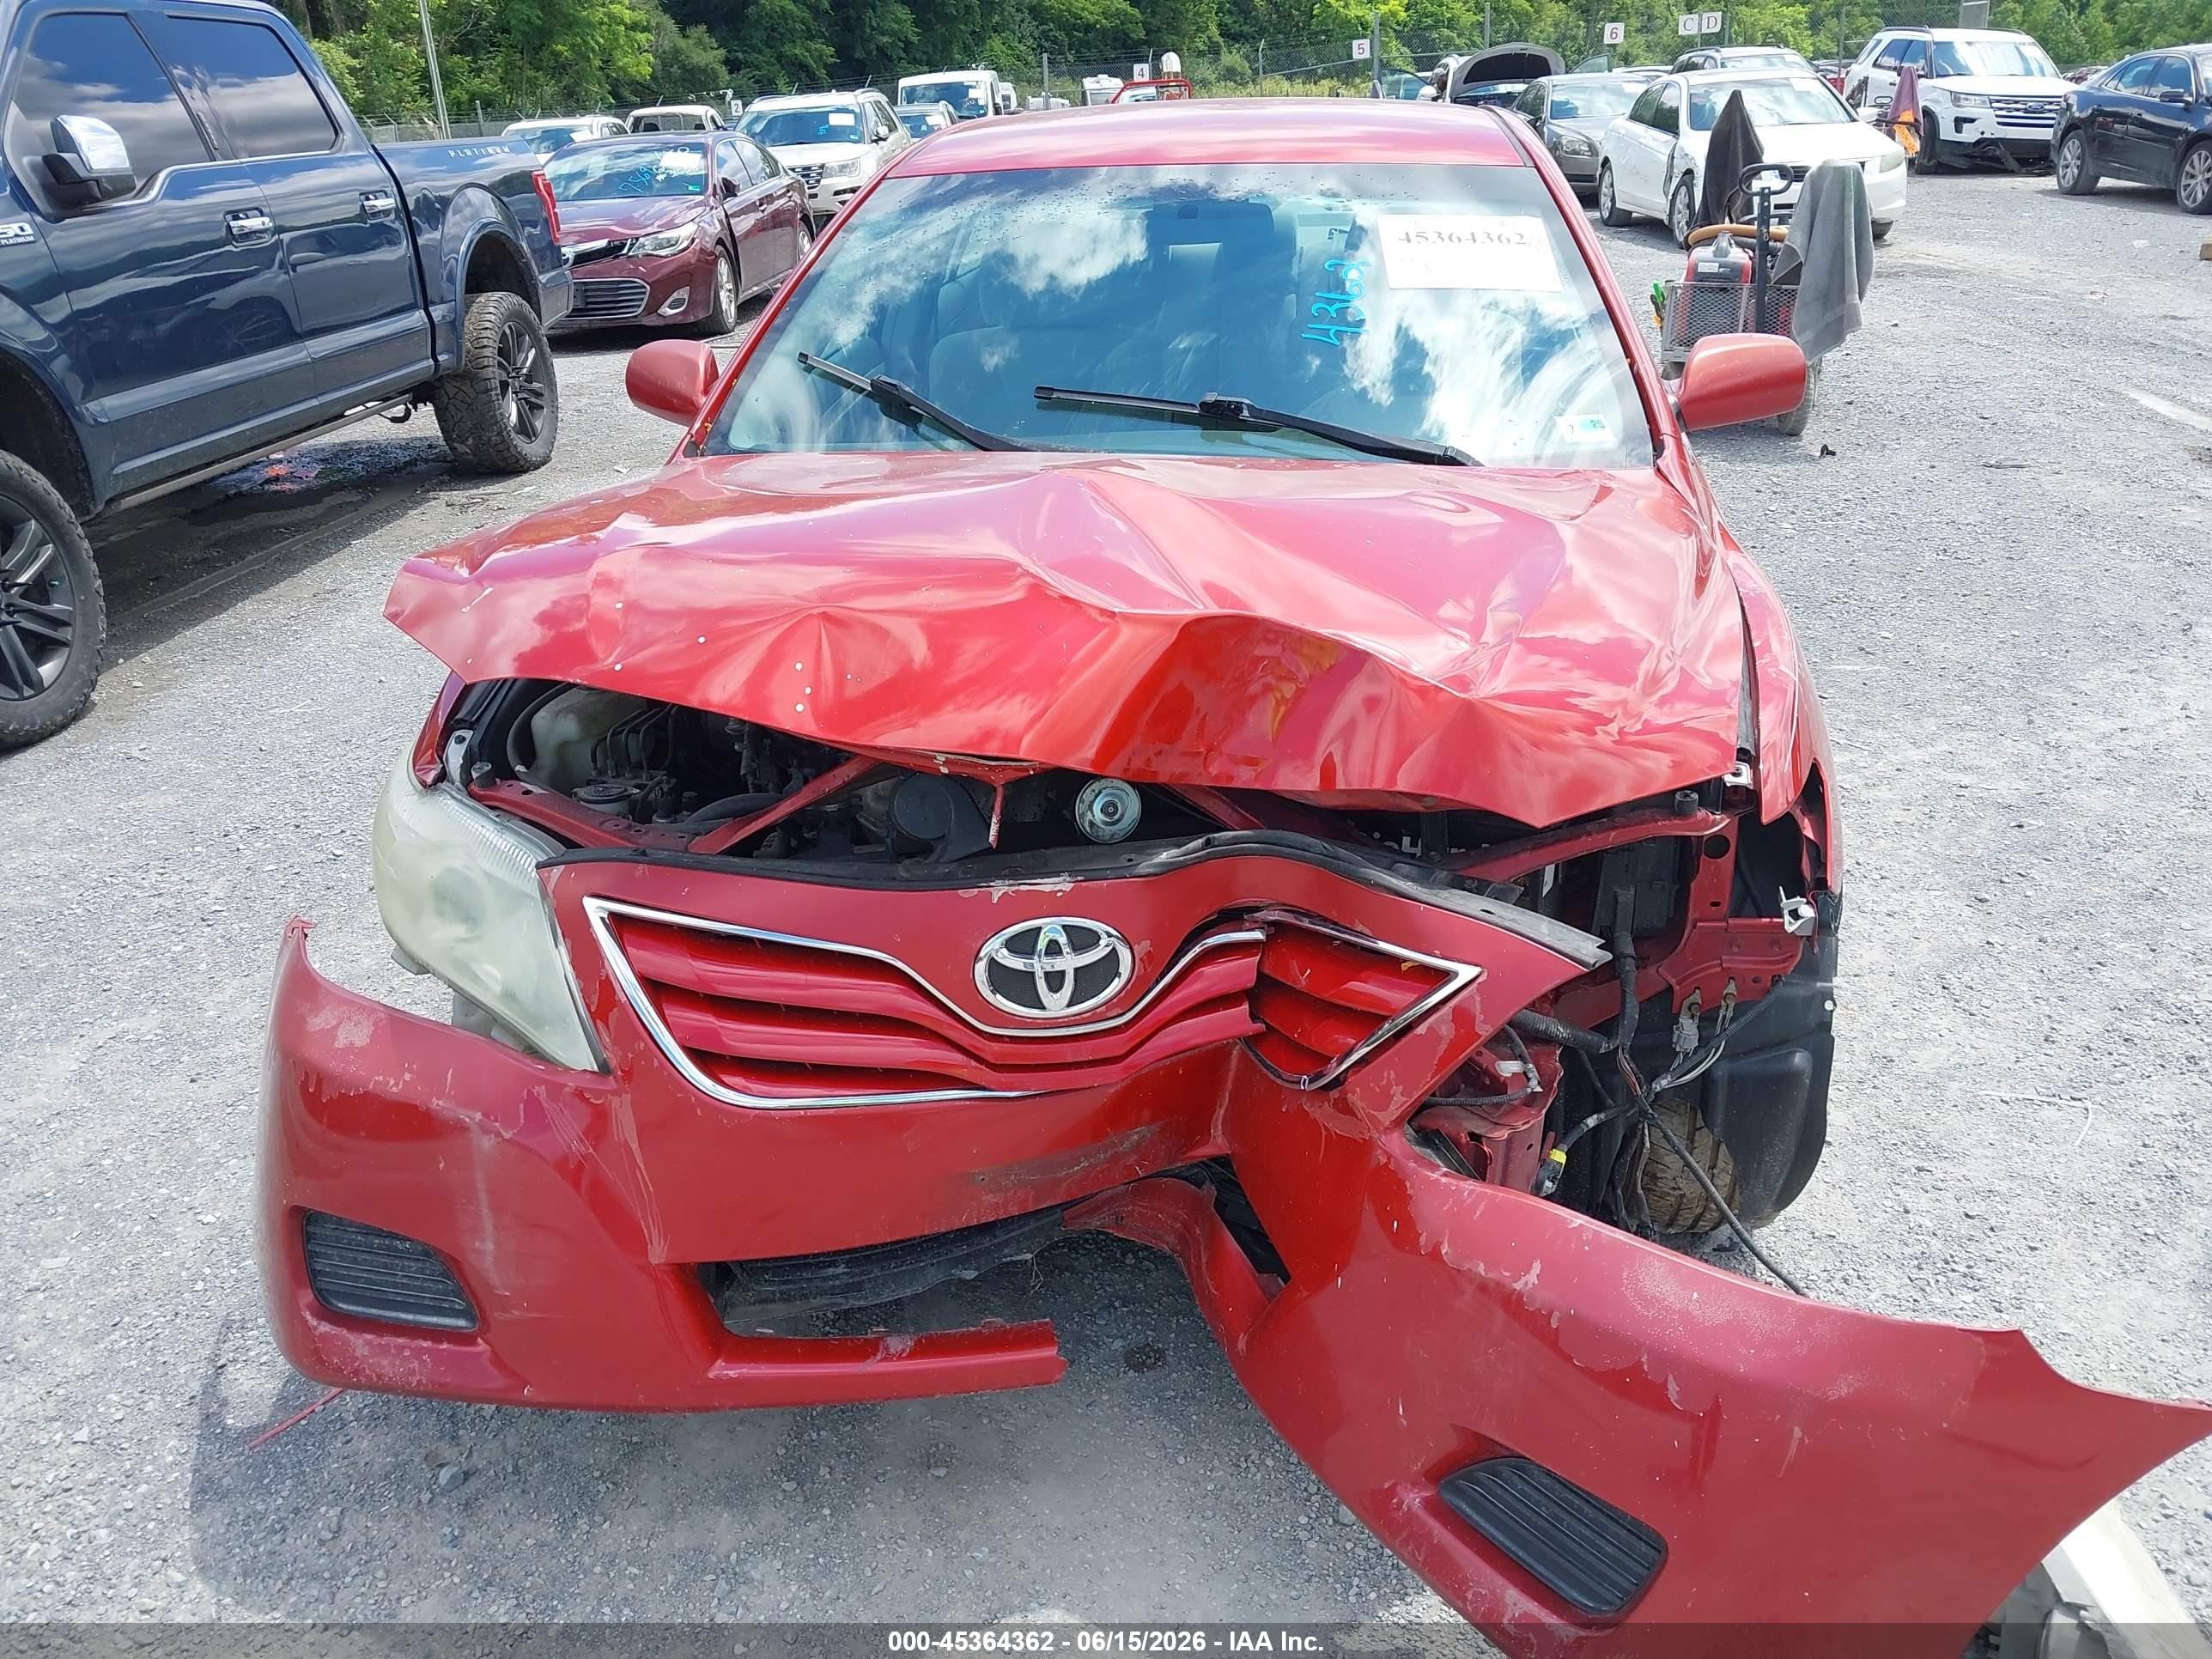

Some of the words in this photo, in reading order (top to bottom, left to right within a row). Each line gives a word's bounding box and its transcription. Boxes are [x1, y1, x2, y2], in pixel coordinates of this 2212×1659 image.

[1683, 17, 1694, 31] C
[1706, 15, 1718, 29] D
[1609, 27, 1619, 40] 6
[1358, 43, 1365, 56] 5
[1138, 67, 1146, 79] 4
[734, 103, 740, 113] 2
[447, 145, 511, 158] PLATINUM
[1, 235, 35, 246] PLATINUM
[1398, 229, 1527, 246] 45364362
